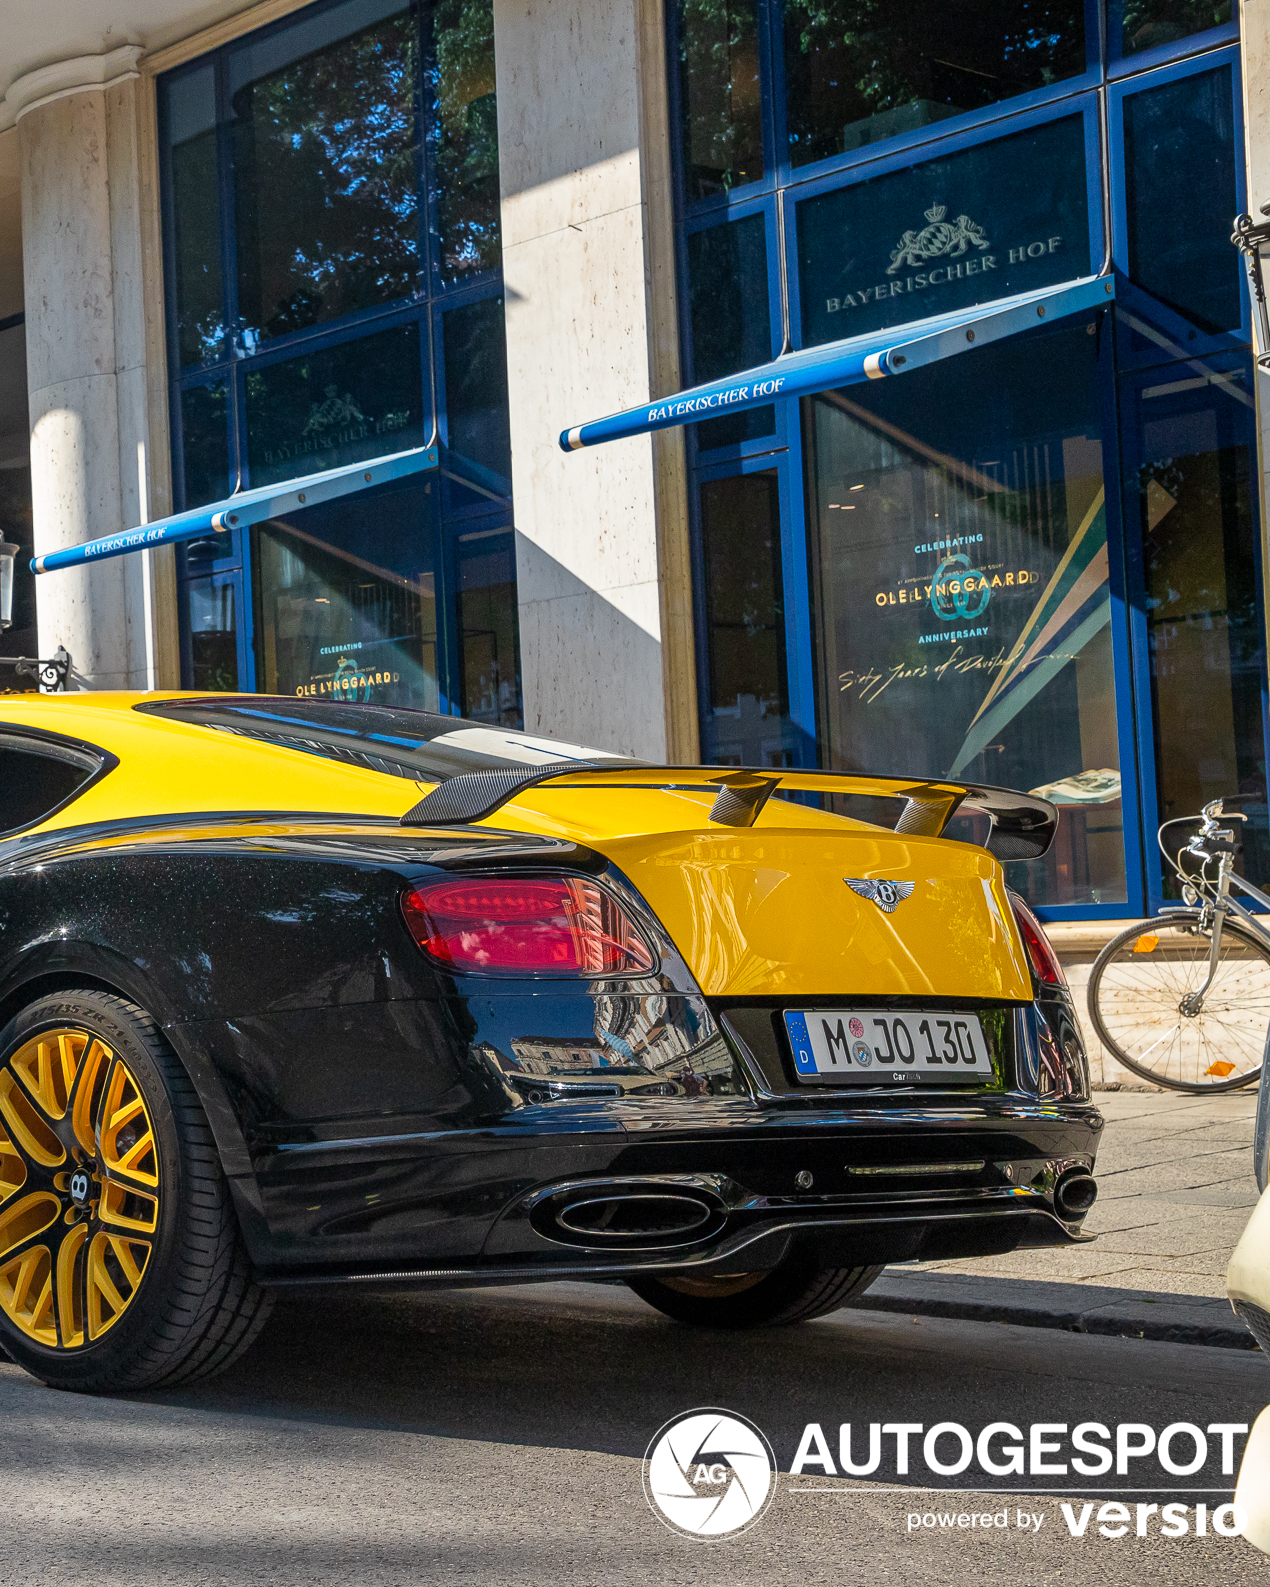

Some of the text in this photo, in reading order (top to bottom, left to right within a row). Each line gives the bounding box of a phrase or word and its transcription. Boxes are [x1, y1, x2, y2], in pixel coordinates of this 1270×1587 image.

[826, 236, 1063, 313] BAYERISCHER HOF
[648, 377, 786, 422] BAYERISCHER HOF
[85, 526, 168, 557] BAYERISCHER HOF
[914, 533, 984, 554] CELEBRATING
[875, 589, 908, 607] OLE
[914, 570, 1030, 600] LYNGGAARD
[319, 641, 363, 655] CELEBRATING
[918, 626, 989, 644] ANNIVERSARY
[296, 684, 317, 698] OLE
[320, 671, 391, 694] LYNGGAARD
[28, 1004, 82, 1022] 275/35
[82, 1007, 107, 1023] ZR
[106, 1024, 125, 1038] 21
[799, 1050, 809, 1063] D
[821, 1018, 977, 1065] M JO 130
